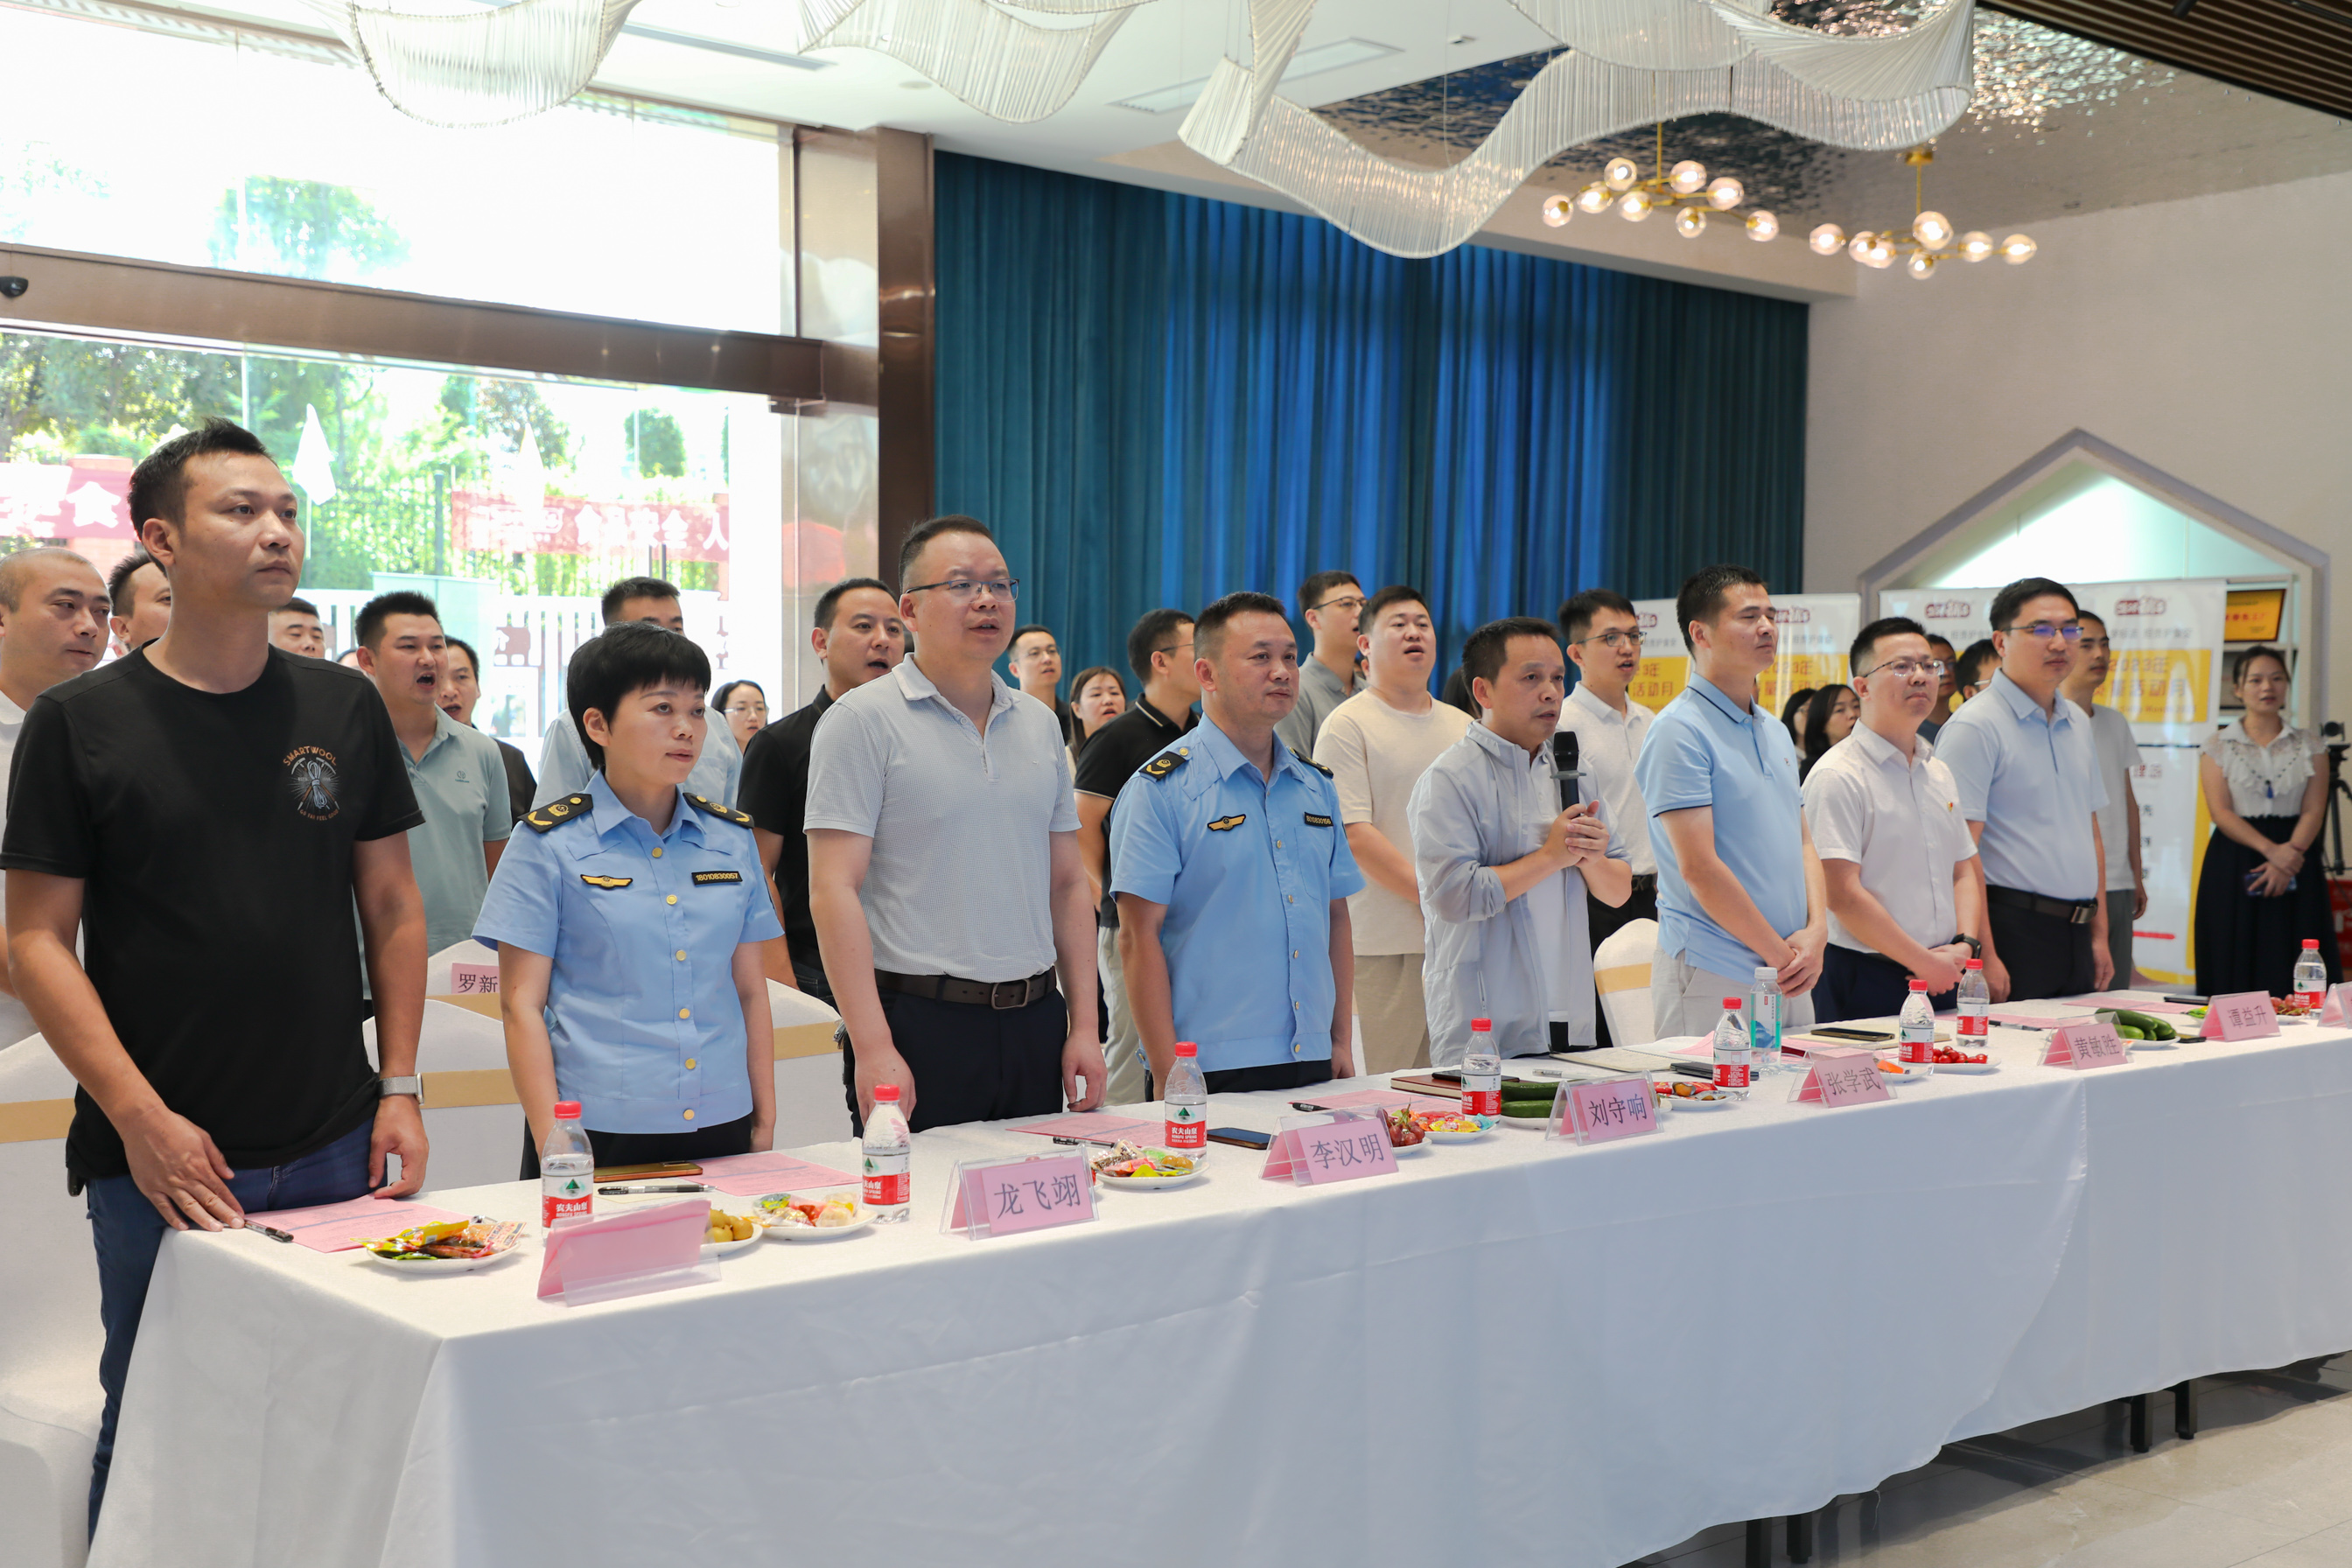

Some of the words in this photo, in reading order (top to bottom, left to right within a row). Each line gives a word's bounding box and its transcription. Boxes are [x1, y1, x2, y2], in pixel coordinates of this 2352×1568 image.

[283, 746, 337, 766] SMARTWOOL
[695, 872, 738, 882] 18010830057
[2227, 1005, 2268, 1029] 谭益升
[2074, 1034, 2120, 1060] 黄敏胜
[1824, 1067, 1881, 1096] 张学武
[1588, 1093, 1648, 1128] 刘守响
[1171, 1126, 1198, 1135] 农夫山泉
[1310, 1133, 1385, 1170] 李汉明
[556, 1200, 589, 1213] 农夫山泉
[993, 1173, 1082, 1220] 龙飞翊
